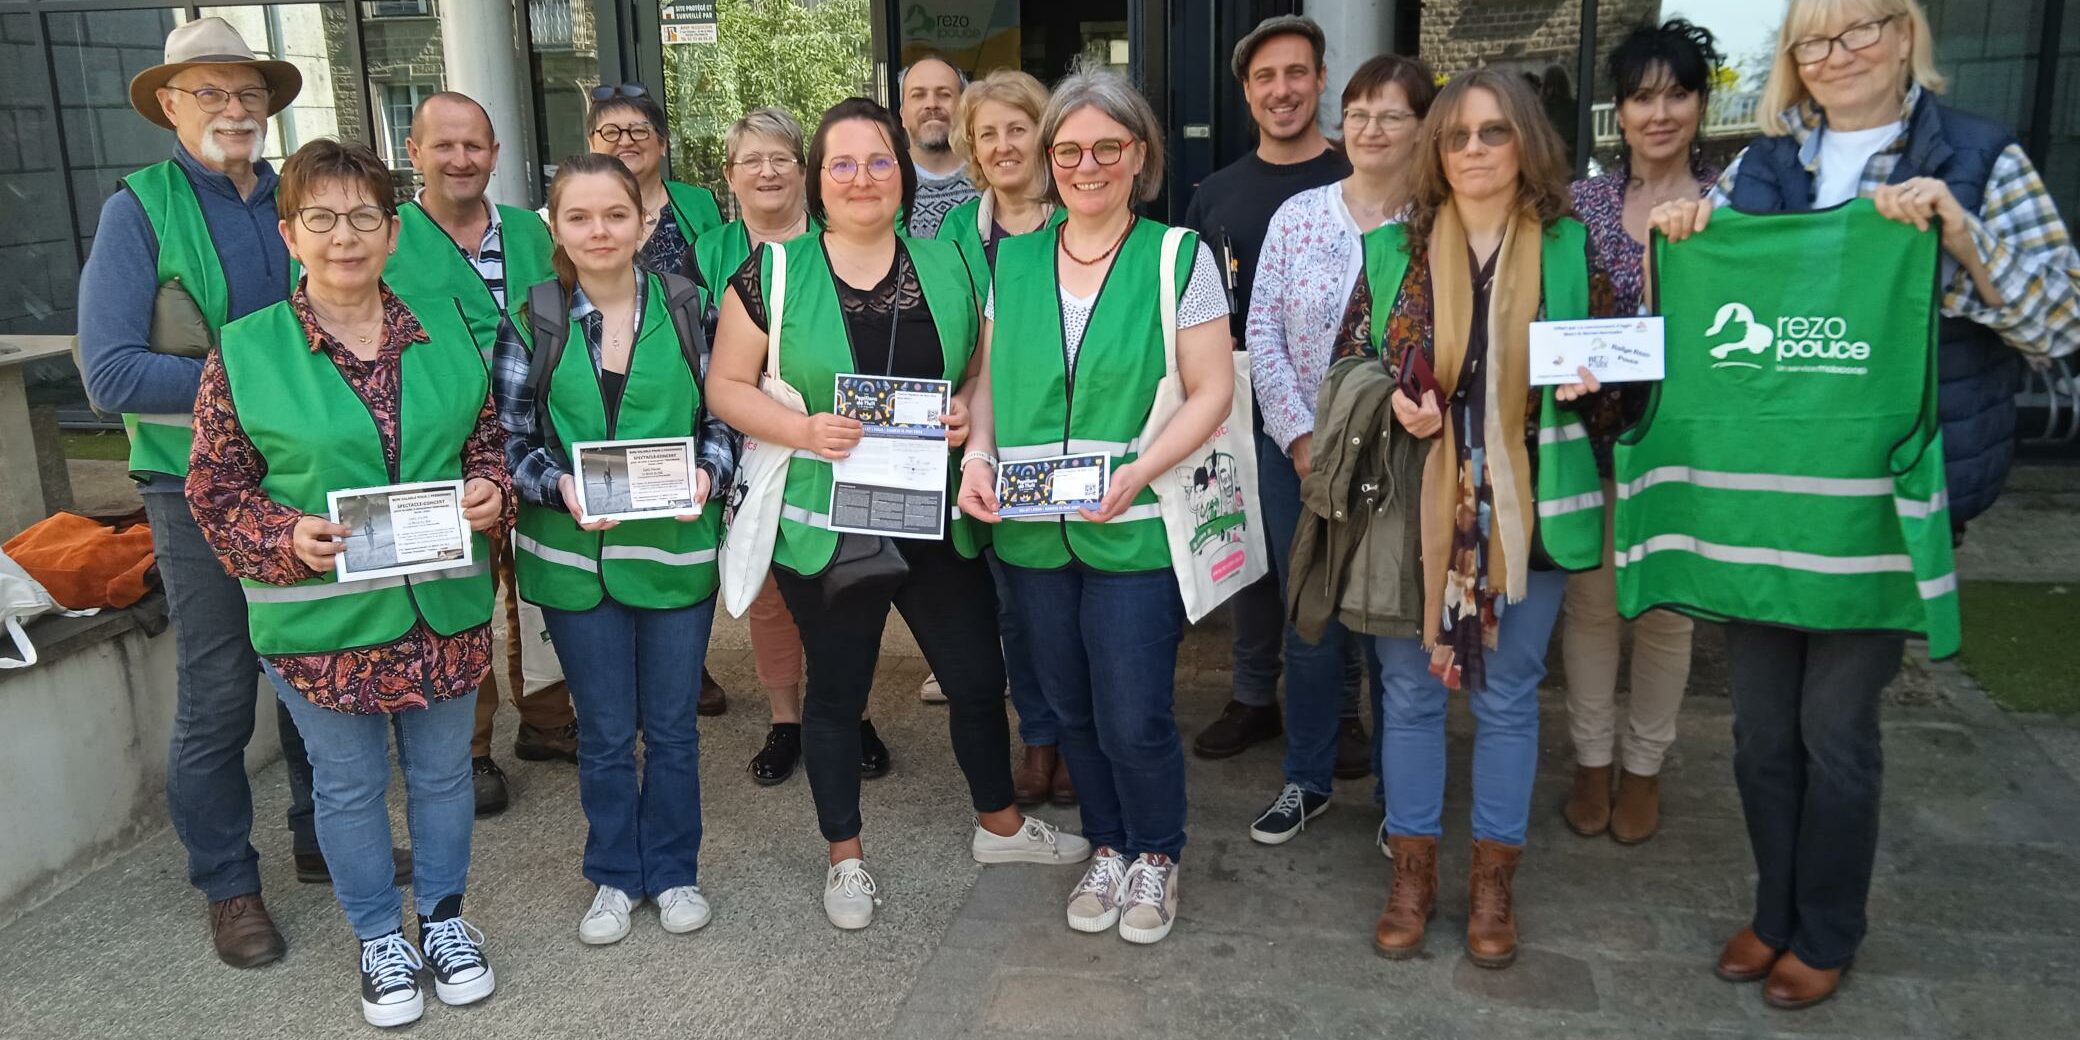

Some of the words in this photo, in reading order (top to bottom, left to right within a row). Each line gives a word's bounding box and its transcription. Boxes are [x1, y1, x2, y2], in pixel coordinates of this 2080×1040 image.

[937, 15, 969, 28] rezo
[1776, 316, 1847, 339] rezo
[1776, 339, 1871, 361] pouce
